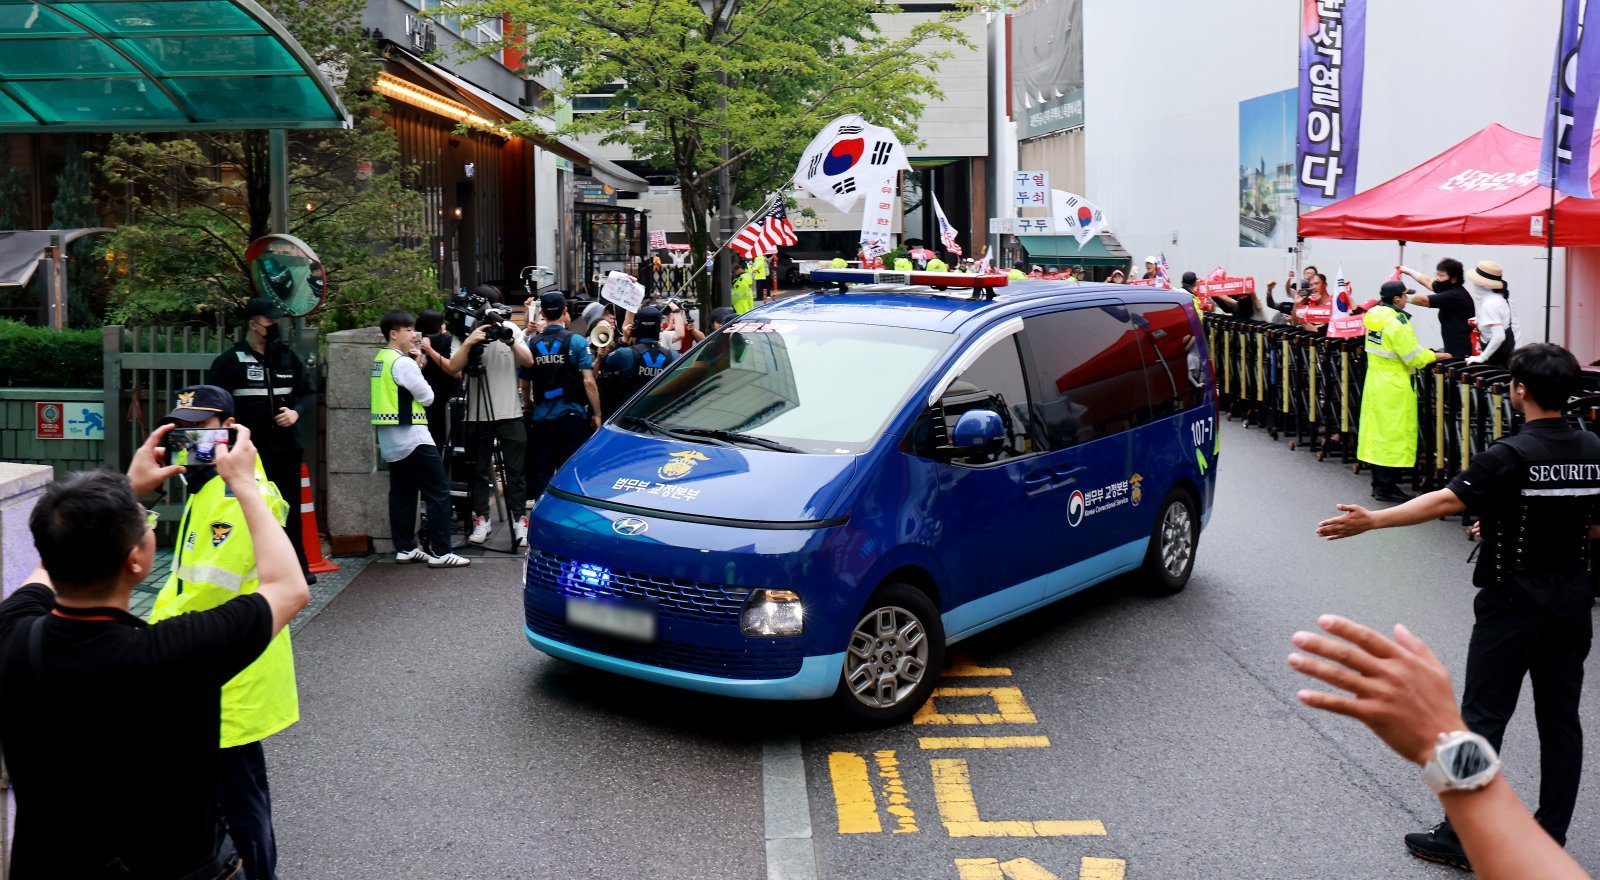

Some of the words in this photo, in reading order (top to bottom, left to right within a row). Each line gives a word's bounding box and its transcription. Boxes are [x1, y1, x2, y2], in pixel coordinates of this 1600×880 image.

[1016, 173, 1030, 206] 구두
[1032, 173, 1045, 205] 열쇠
[1018, 219, 1048, 232] 구두
[536, 354, 565, 366] POLICE
[638, 365, 663, 377] POLIC
[1191, 416, 1213, 447] 107-7
[1529, 463, 1600, 482] SECURITY
[612, 477, 650, 491] 법무부
[648, 482, 701, 501] 교정본부
[1084, 488, 1104, 507] 법무부
[1105, 479, 1129, 500] 교정본부
